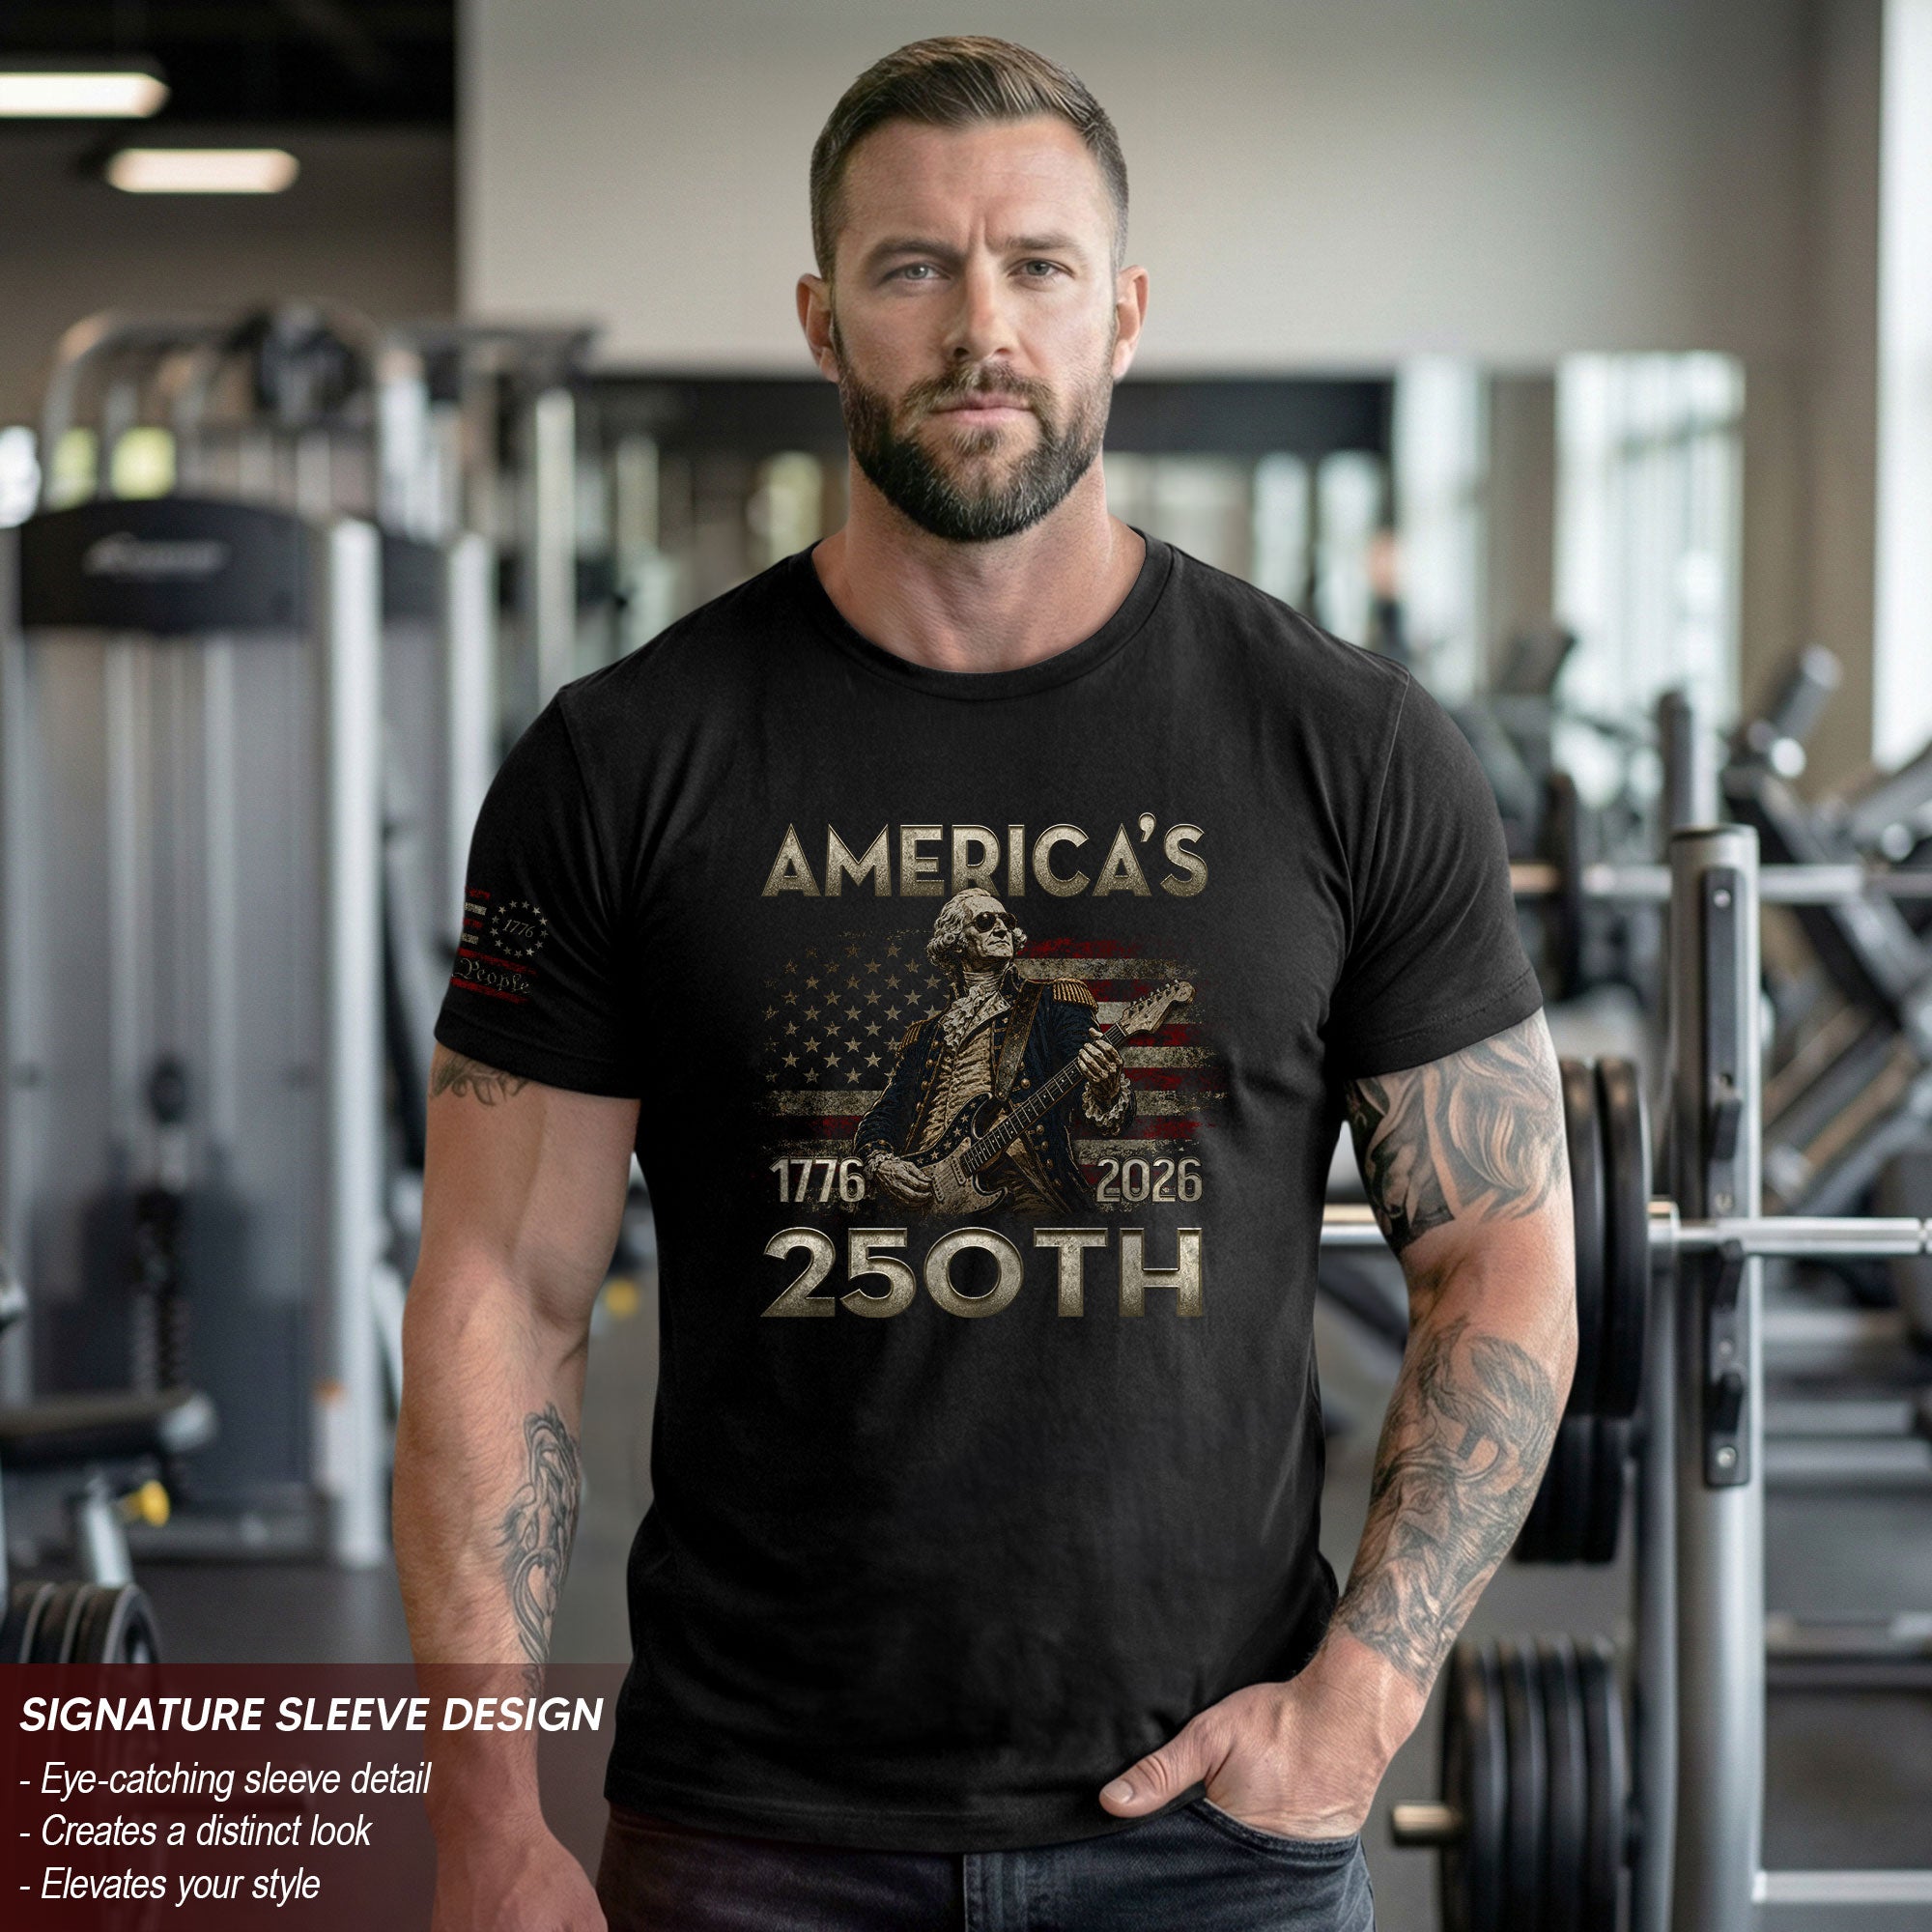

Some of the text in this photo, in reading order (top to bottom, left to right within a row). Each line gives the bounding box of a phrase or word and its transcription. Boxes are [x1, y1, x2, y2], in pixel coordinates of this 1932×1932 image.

[760, 811, 1209, 897] AMERICA'S
[502, 919, 536, 938] 1776
[769, 1156, 867, 1204] 1776
[1095, 1156, 1204, 1204] 2026
[759, 1226, 1205, 1319] 250TH
